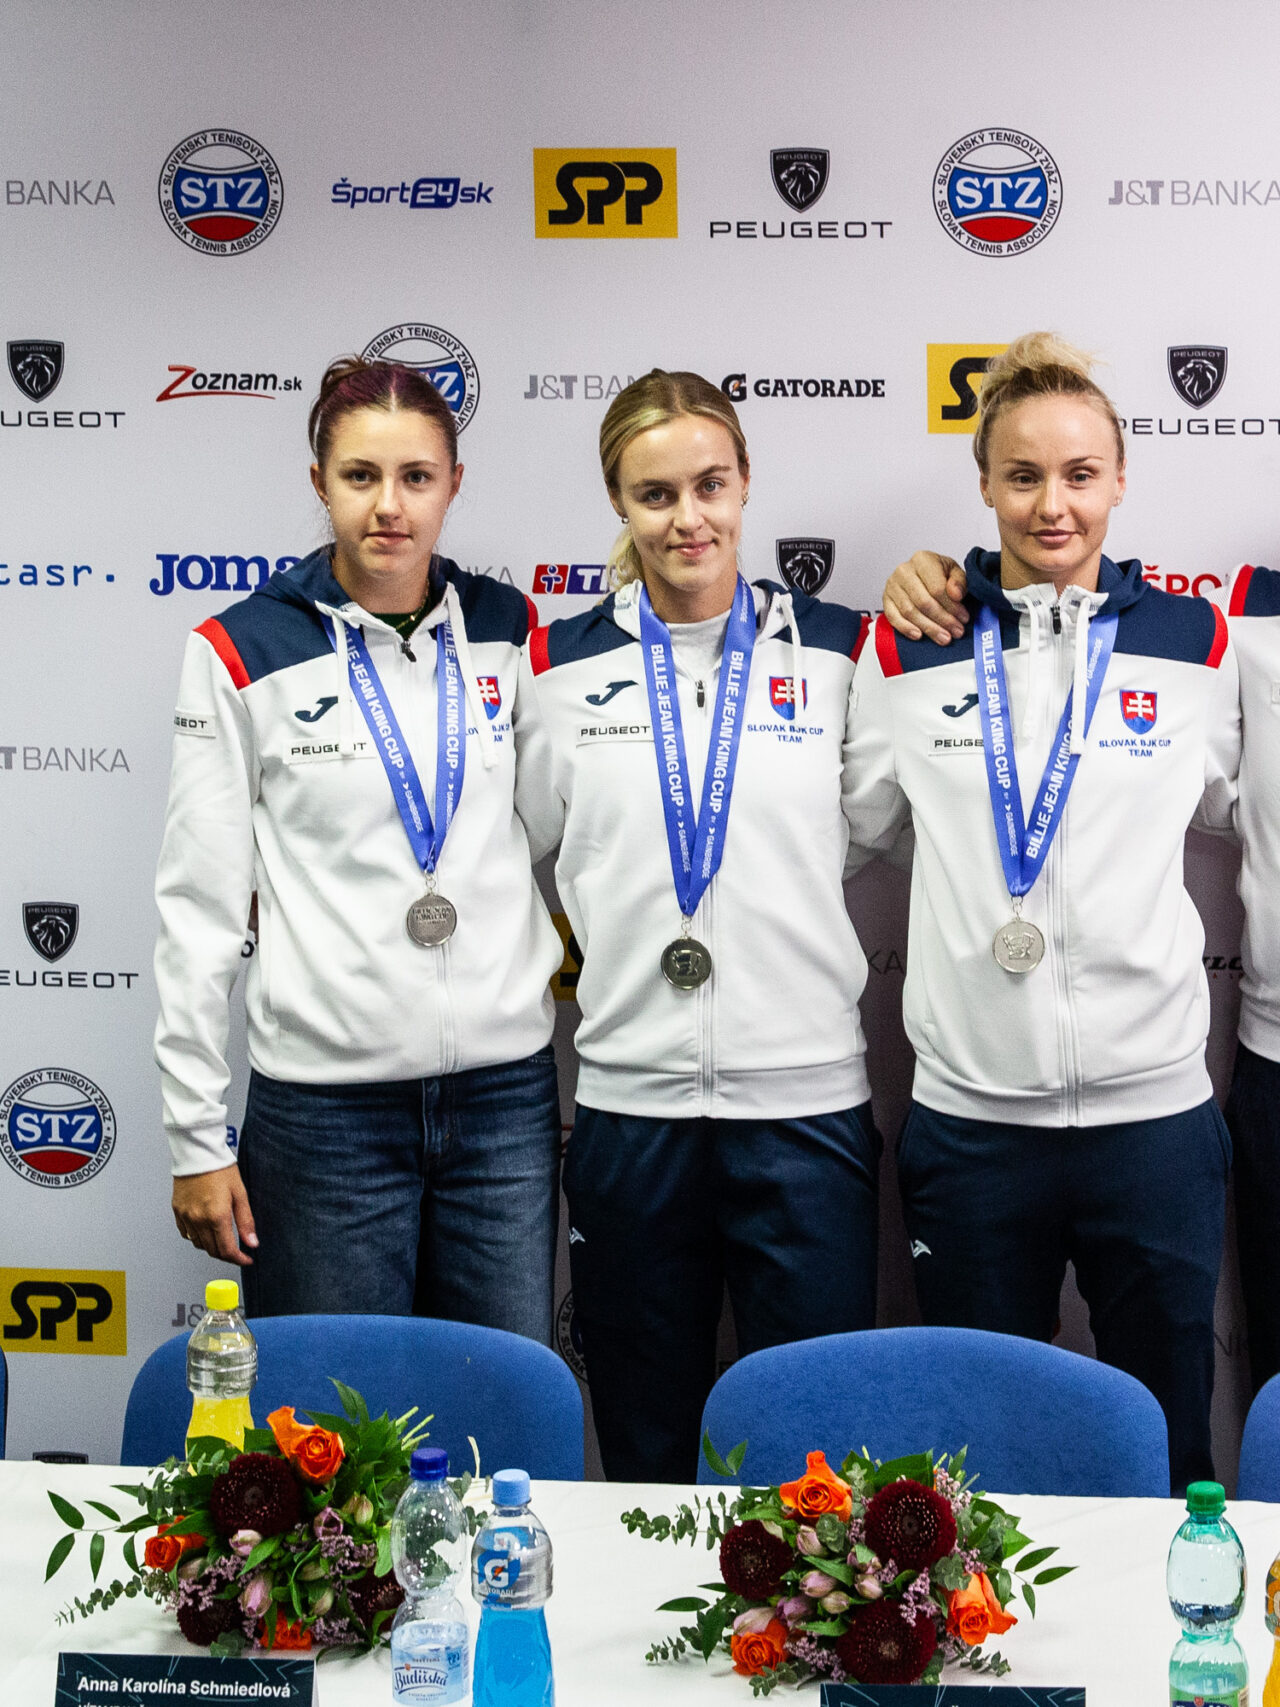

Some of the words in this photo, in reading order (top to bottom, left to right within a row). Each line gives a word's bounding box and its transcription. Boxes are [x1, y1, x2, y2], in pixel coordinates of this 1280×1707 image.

[163, 131, 208, 186] SLOVENSKÝ
[211, 133, 264, 158] TENISOVÝ
[938, 131, 985, 186] SLOVENSKÝ
[988, 132, 1043, 157] TENISOVÝ
[6, 180, 115, 205] BANKA
[180, 177, 264, 208] STZ
[548, 161, 663, 226] SPP
[955, 176, 1042, 209] STZ
[1108, 180, 1164, 206] J&T
[163, 199, 190, 240] SLOVAK
[190, 235, 227, 253] TENNIS
[230, 200, 280, 252] ASSOCIATION
[709, 221, 893, 239] PEUGEOT
[938, 199, 965, 240] SLOVAK
[965, 236, 1003, 254] TENNIS
[1007, 200, 1058, 253] ASSOCIATION
[407, 327, 461, 352] TENISOVÝ
[156, 365, 302, 402] Zoznam.sk
[524, 374, 577, 399] J&T
[754, 378, 885, 398] GATORADE
[0, 411, 126, 428] UGEOT
[651, 644, 668, 690] BILLIE
[981, 630, 997, 675] BILLIE
[445, 658, 459, 698] JEAN
[726, 650, 744, 697] BILLIE
[985, 675, 1001, 716] JEAN
[352, 661, 377, 698] JEAN
[367, 697, 393, 739] KING
[383, 737, 405, 769] CUP
[446, 698, 459, 736] KING
[656, 691, 675, 734] JEAN
[719, 697, 738, 739] JEAN
[580, 726, 650, 737] PEUGEOT
[747, 724, 787, 734] SLOVAK
[808, 727, 824, 736] CUP
[777, 735, 803, 744] TEAM
[934, 739, 984, 748] PEUGE
[990, 716, 1007, 756] KING
[1099, 739, 1137, 748] SLOVAK
[1157, 739, 1171, 748] CUP
[23, 747, 131, 773] BANKA
[291, 742, 367, 755] PEUGET
[446, 737, 460, 769] CUP
[662, 734, 680, 773] KING
[713, 739, 732, 779] KING
[1129, 749, 1153, 758] TEAM
[994, 756, 1011, 789] CUP
[668, 774, 685, 807] CUP
[709, 779, 725, 813] CUP
[1025, 811, 1052, 859] BILLIE
[1042, 769, 1065, 813] JEAN
[0, 970, 139, 989] EUGEOT
[47, 1072, 98, 1096] TENISOVÝ
[16, 1112, 97, 1143] STZ
[0, 1133, 25, 1171] SLOVAK
[25, 1168, 61, 1185] TENNIS
[64, 1136, 112, 1185] ASSOCIATION
[3, 1281, 113, 1342] SPP
[77, 1677, 118, 1692] Anna
[122, 1679, 186, 1694] Karolína
[190, 1680, 291, 1698] Schmiedlová
